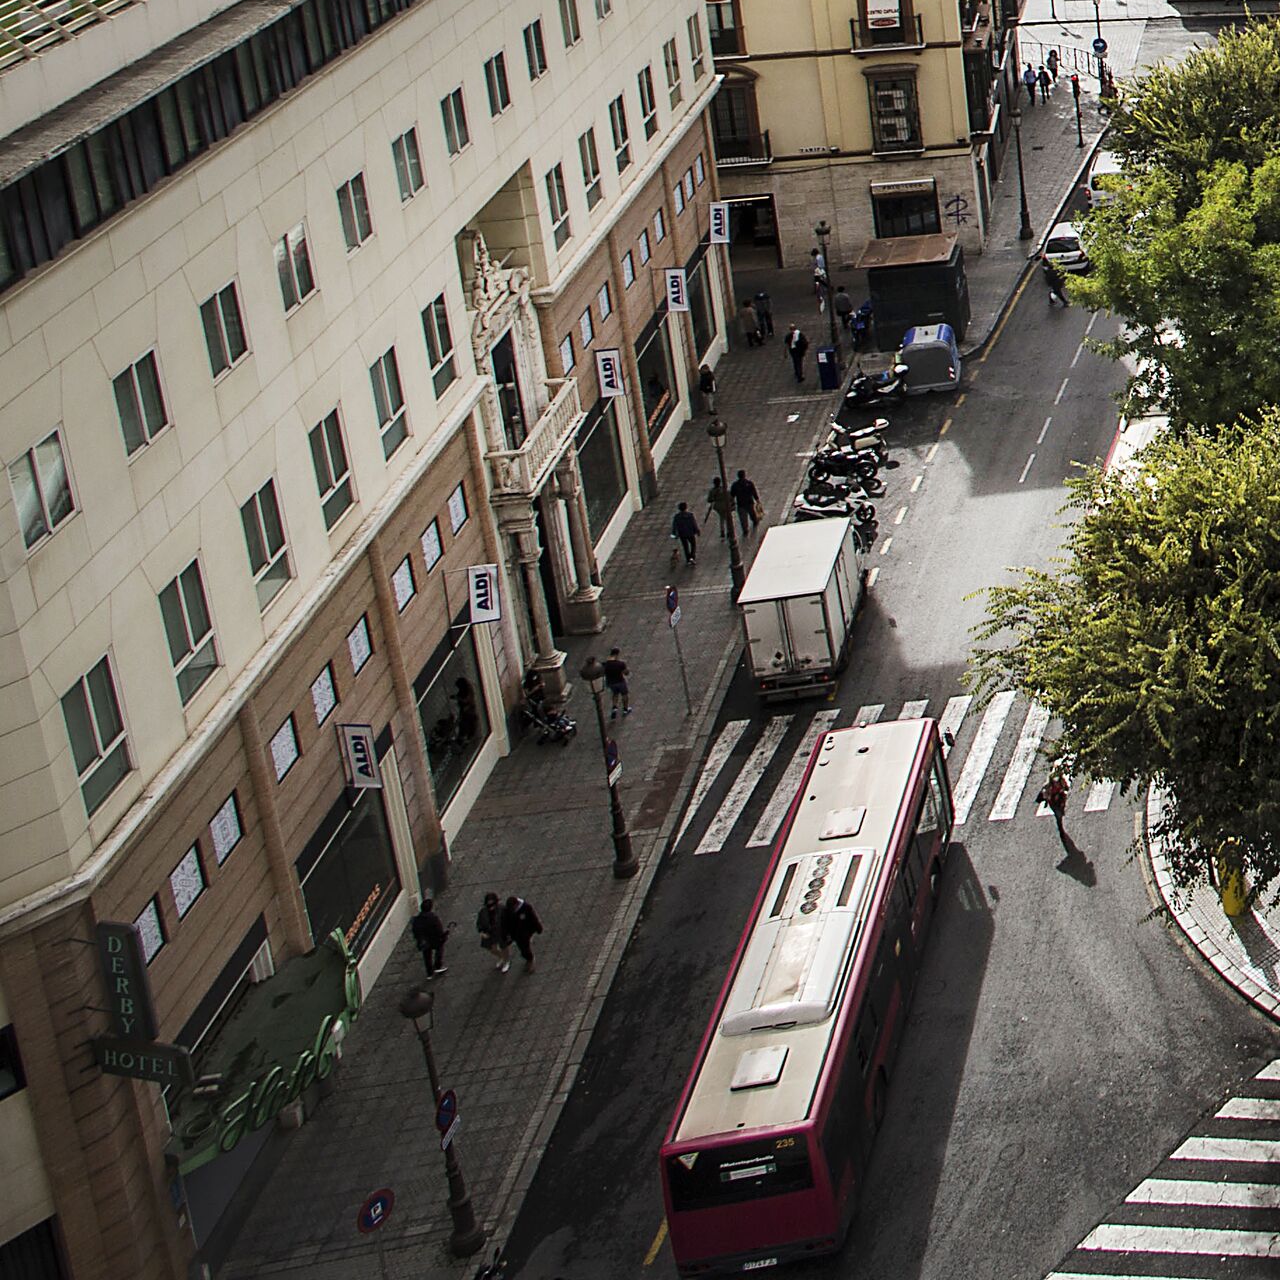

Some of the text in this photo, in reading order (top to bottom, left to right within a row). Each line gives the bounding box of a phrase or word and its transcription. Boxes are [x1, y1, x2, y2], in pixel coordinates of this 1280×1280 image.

[713, 208, 723, 236] ALDI
[670, 275, 681, 305] ALDI
[601, 357, 617, 389] ALDI
[475, 573, 491, 611] ALDI
[351, 735, 372, 779] ALDI
[107, 935, 136, 1034] DERBY
[103, 1049, 180, 1077] HOTEL
[775, 1137, 795, 1150] 235
